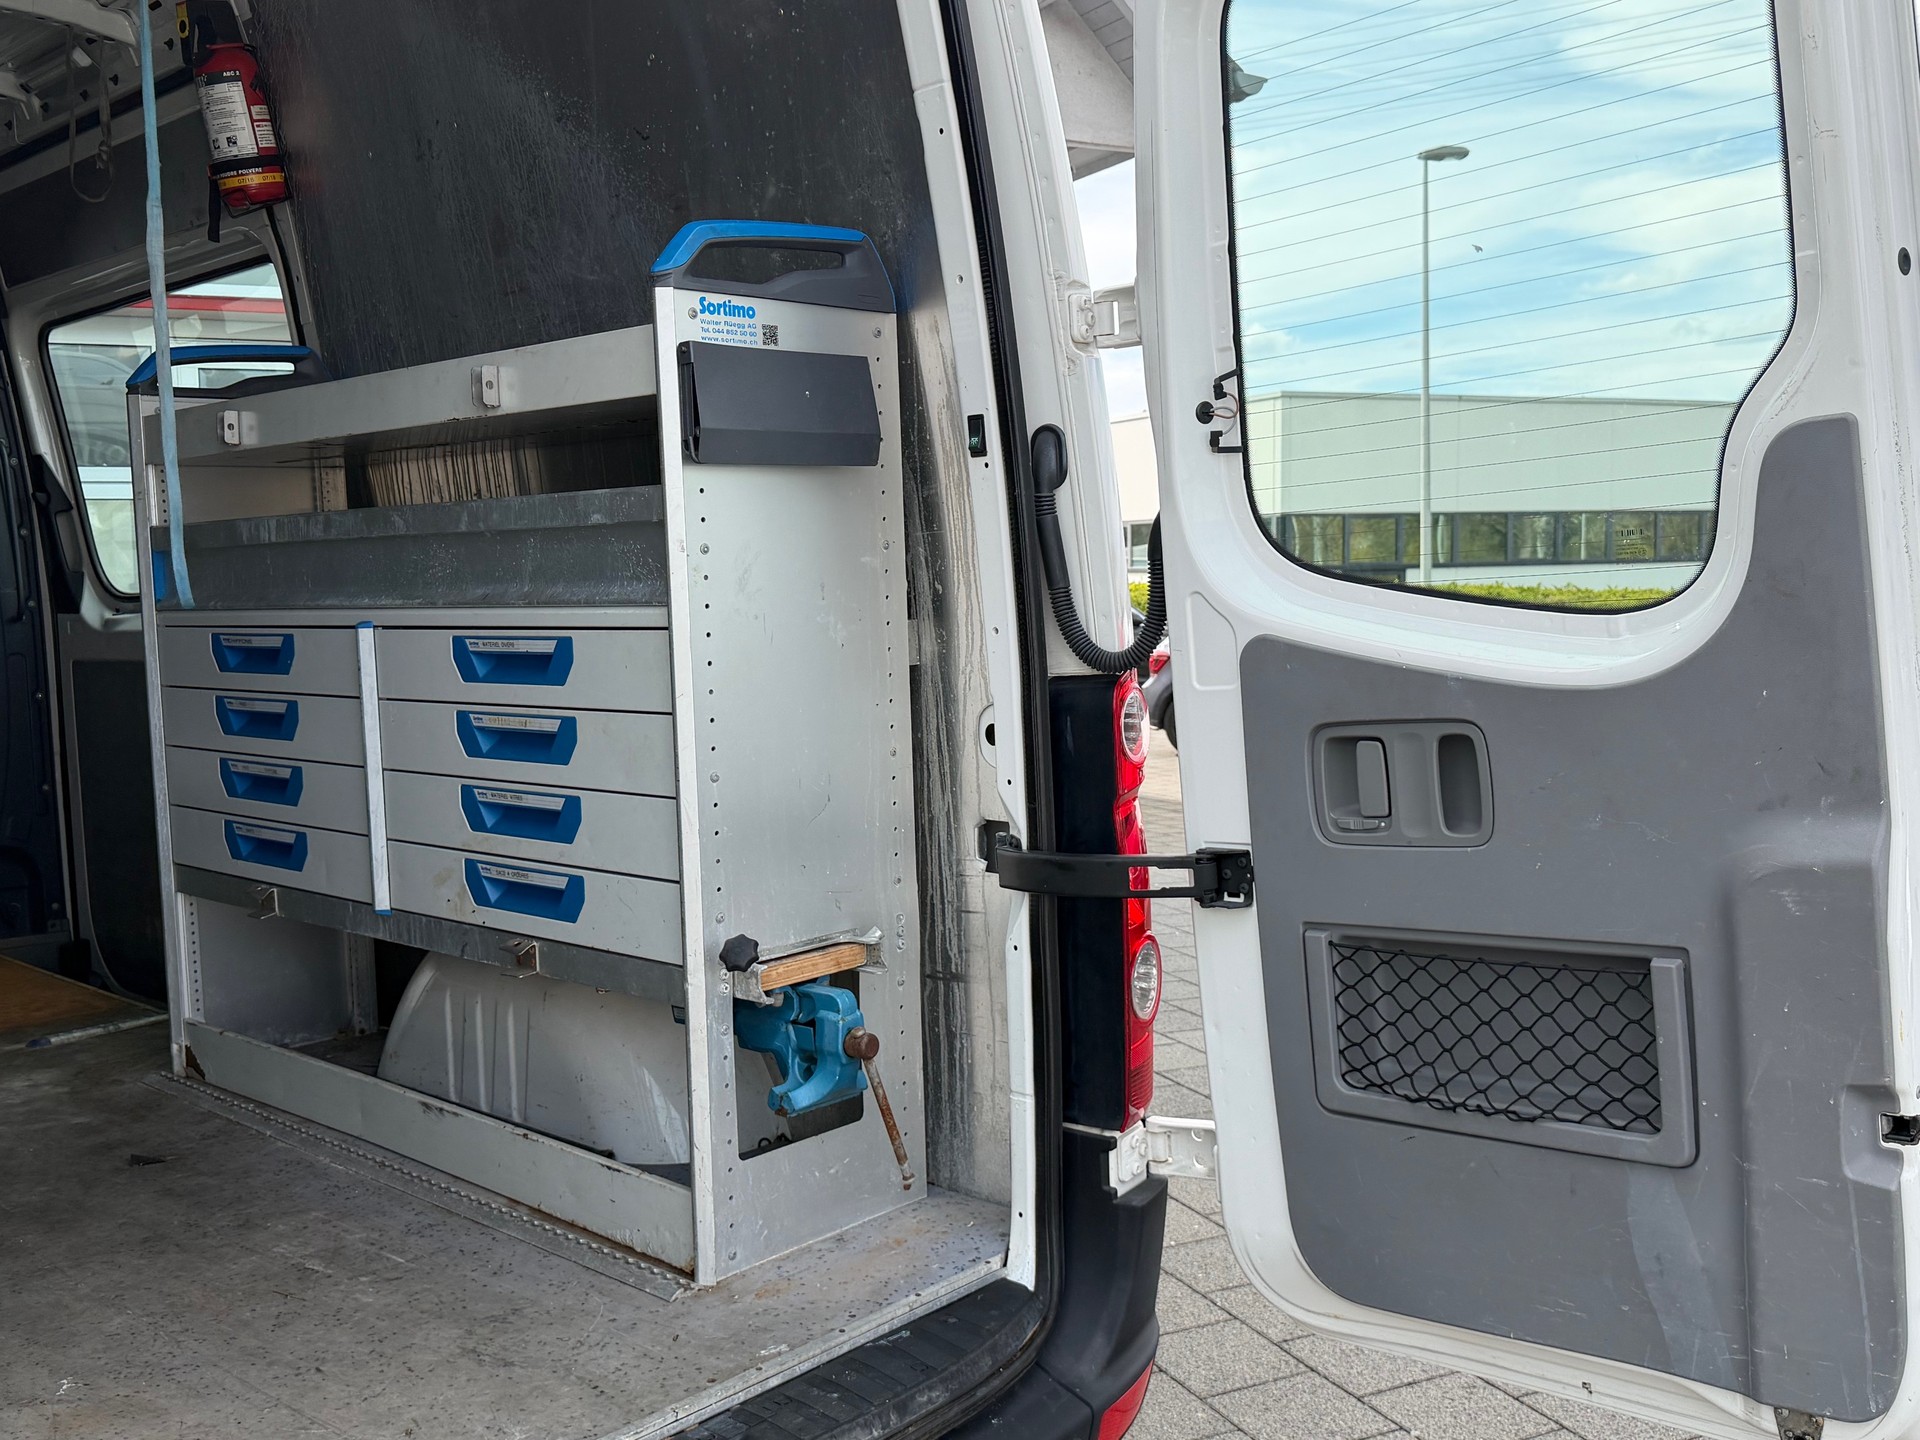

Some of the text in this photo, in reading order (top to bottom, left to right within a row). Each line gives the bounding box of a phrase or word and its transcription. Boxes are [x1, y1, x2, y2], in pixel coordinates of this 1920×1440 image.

[238, 167, 263, 175] POLVERE
[699, 296, 756, 319] Sortimo
[700, 318, 757, 330] Walter Rüegg AG
[701, 336, 758, 345] www.sortimo.ch
